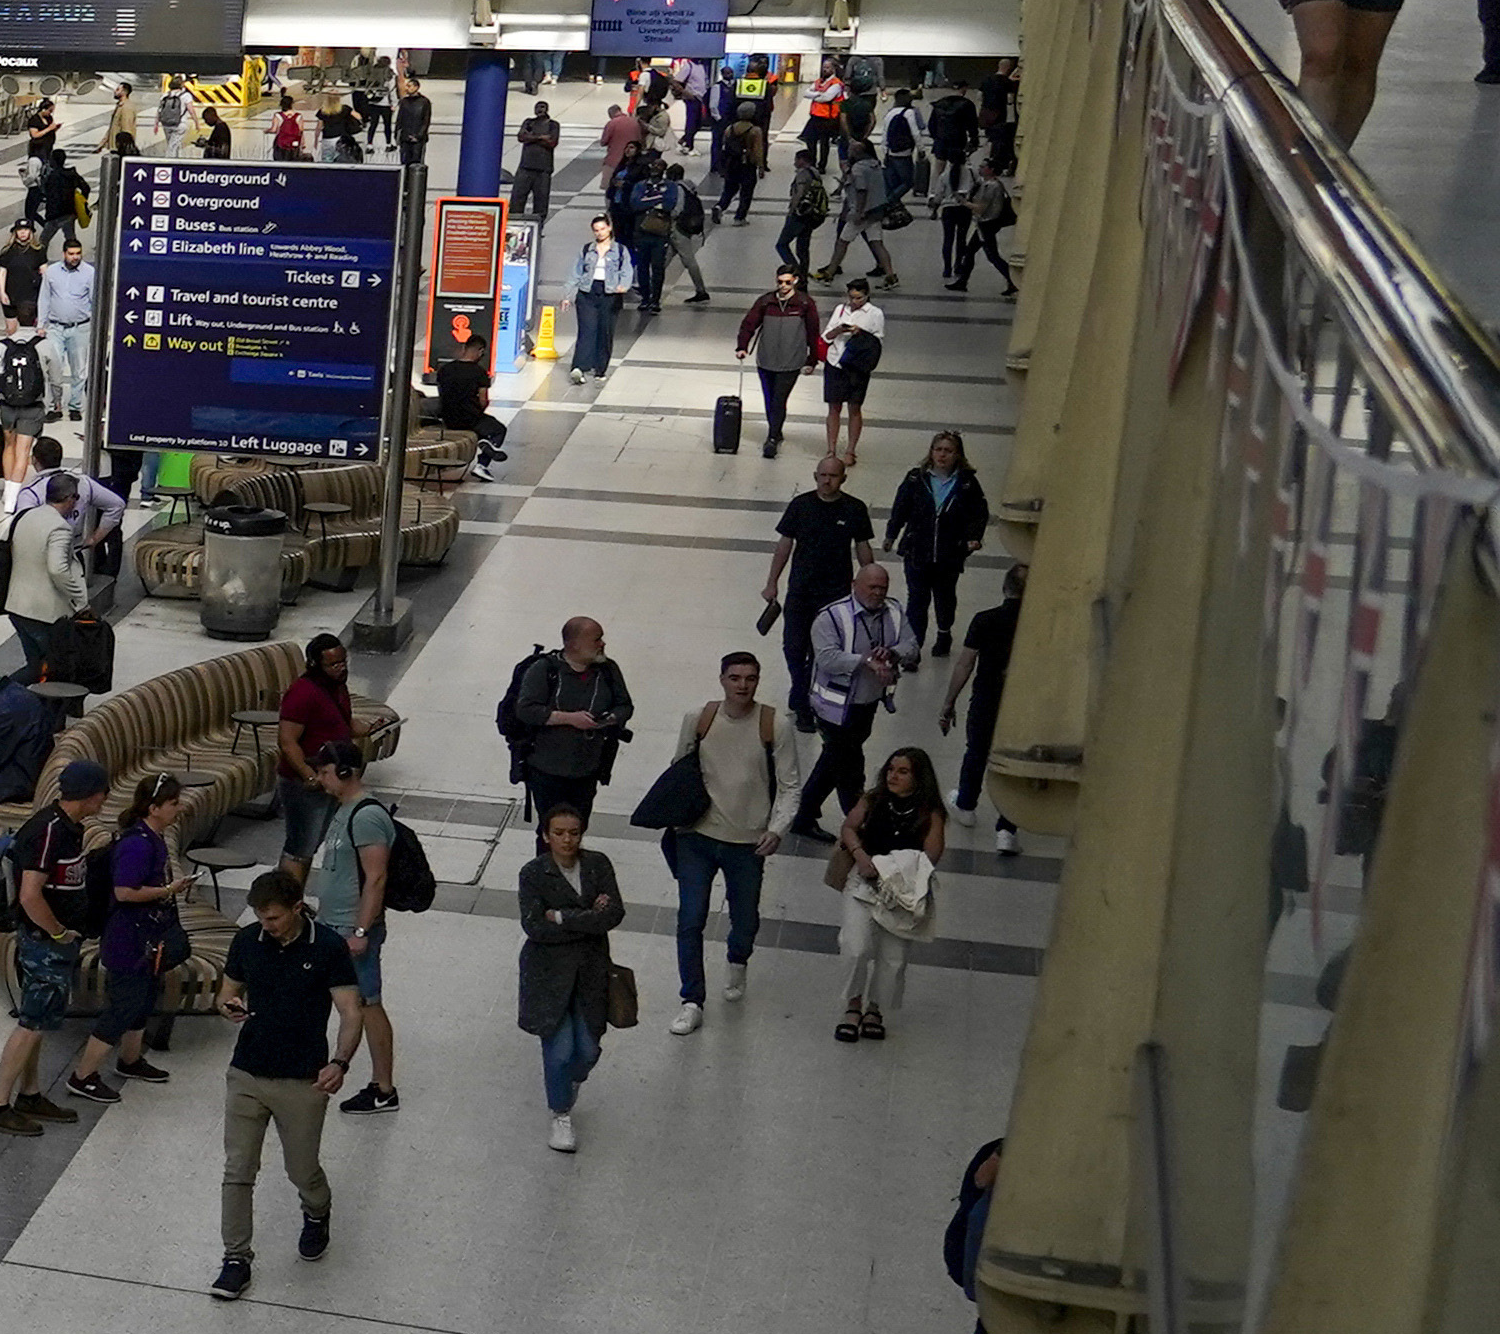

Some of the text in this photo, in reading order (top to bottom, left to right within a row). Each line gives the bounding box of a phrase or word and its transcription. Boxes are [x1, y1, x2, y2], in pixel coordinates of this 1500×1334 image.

[38, 4, 97, 24] PLUS
[638, 26, 680, 35] Liverpool
[643, 35, 673, 44] Strada
[179, 170, 270, 186] Underground
[177, 194, 260, 210] Overground
[176, 218, 215, 232] Buses
[172, 239, 265, 256] Elizabeth line
[285, 270, 335, 284] Tickets
[170, 289, 338, 308] Travel and tourist centre
[169, 313, 192, 327] Lift
[167, 337, 196, 353] Way
[199, 339, 224, 352] out
[231, 436, 322, 454] Left Luggage
